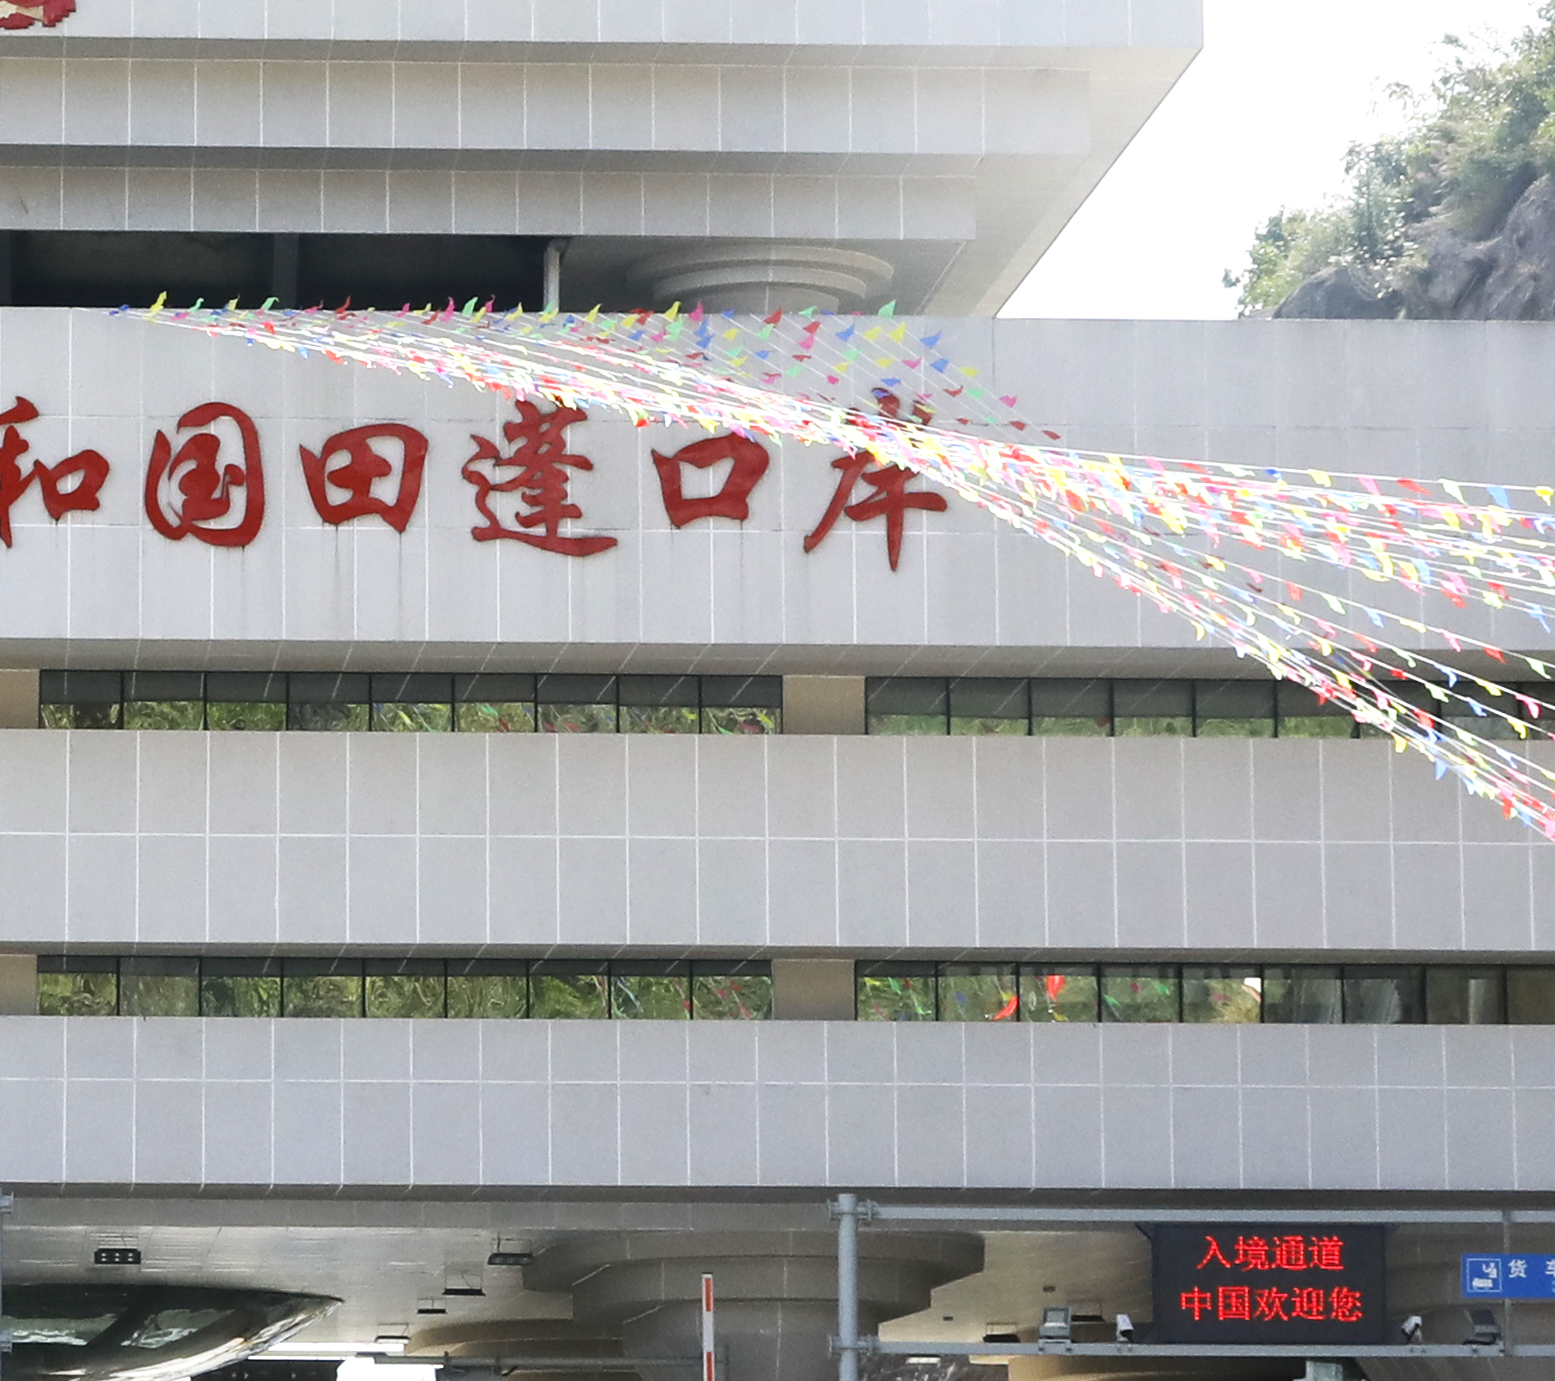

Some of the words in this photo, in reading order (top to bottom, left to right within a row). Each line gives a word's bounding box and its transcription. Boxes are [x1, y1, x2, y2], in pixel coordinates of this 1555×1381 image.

[1196, 1235, 1345, 1272] 入境通道
[1180, 1285, 1364, 1323] 中国欢迎您
